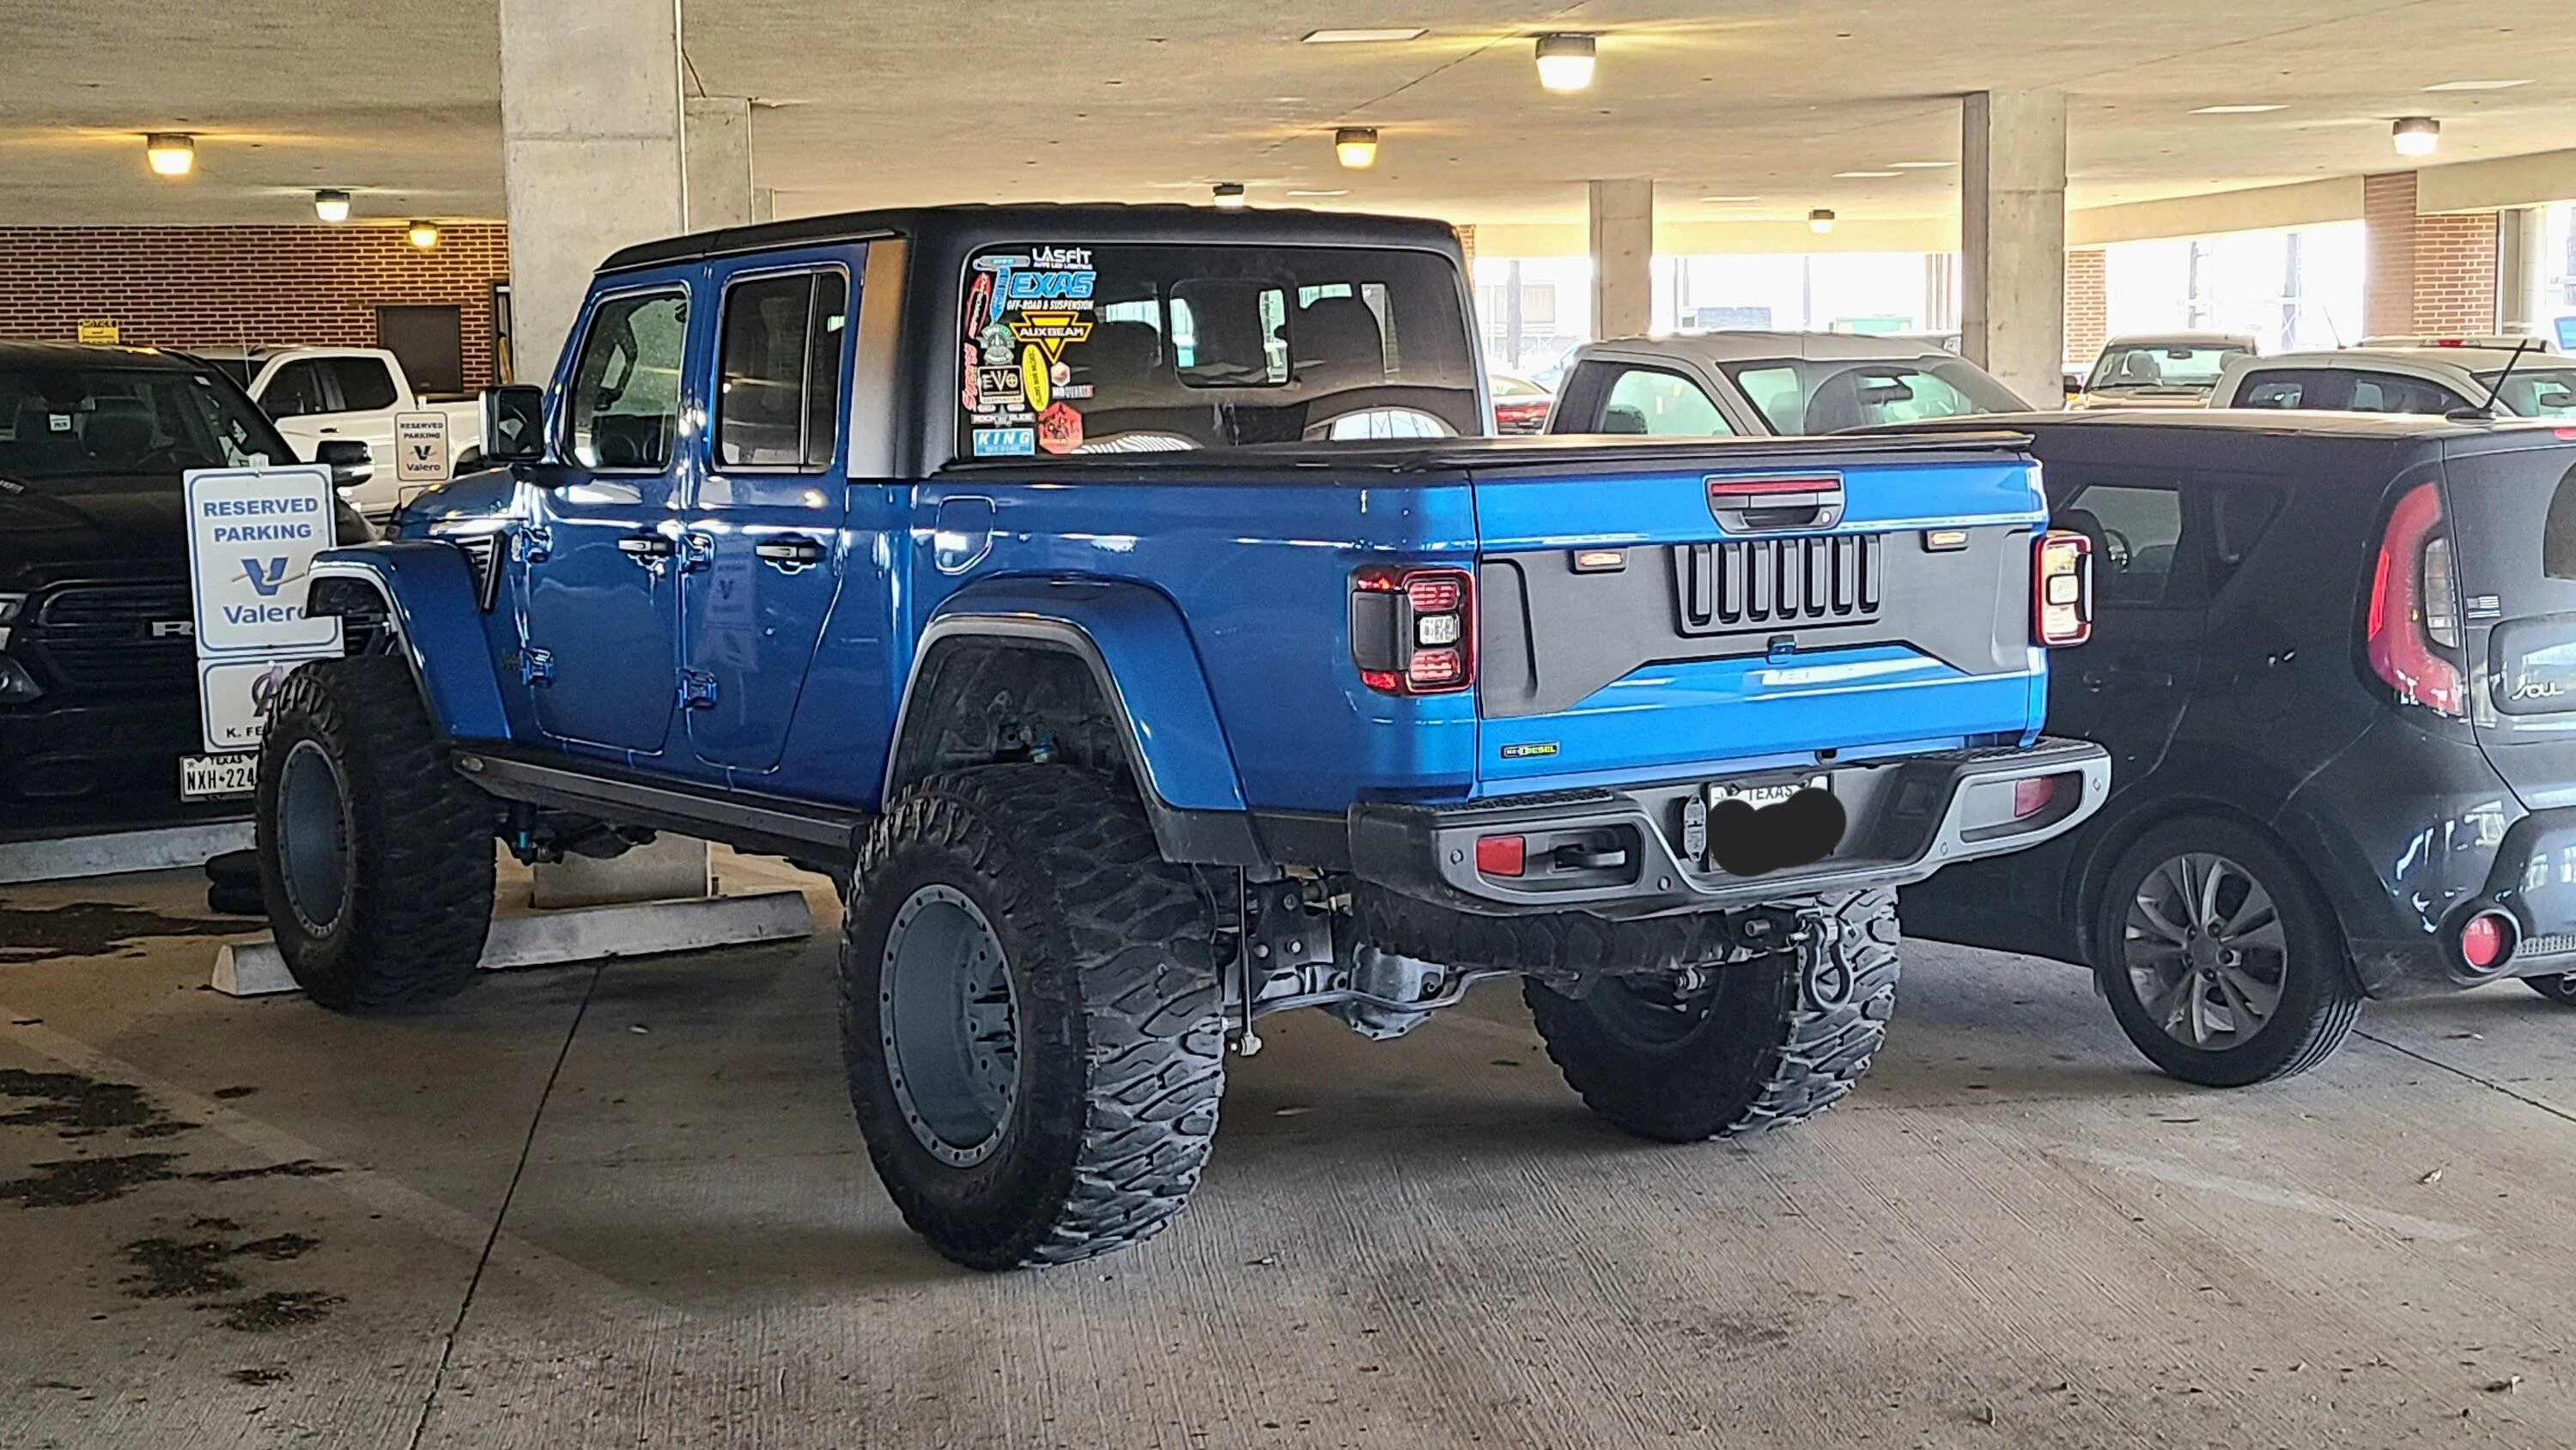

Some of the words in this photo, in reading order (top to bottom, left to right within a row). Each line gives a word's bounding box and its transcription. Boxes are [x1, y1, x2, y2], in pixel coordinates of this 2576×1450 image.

[1032, 246, 1092, 264] LASFIT
[1019, 327, 1084, 337] AUXBEAM
[981, 370, 1018, 391] EVO
[978, 431, 1031, 446] KING
[204, 498, 319, 517] RESERVED
[214, 524, 312, 543] PARKING
[226, 727, 241, 738] K.
[1748, 786, 1794, 801] TEXAS
